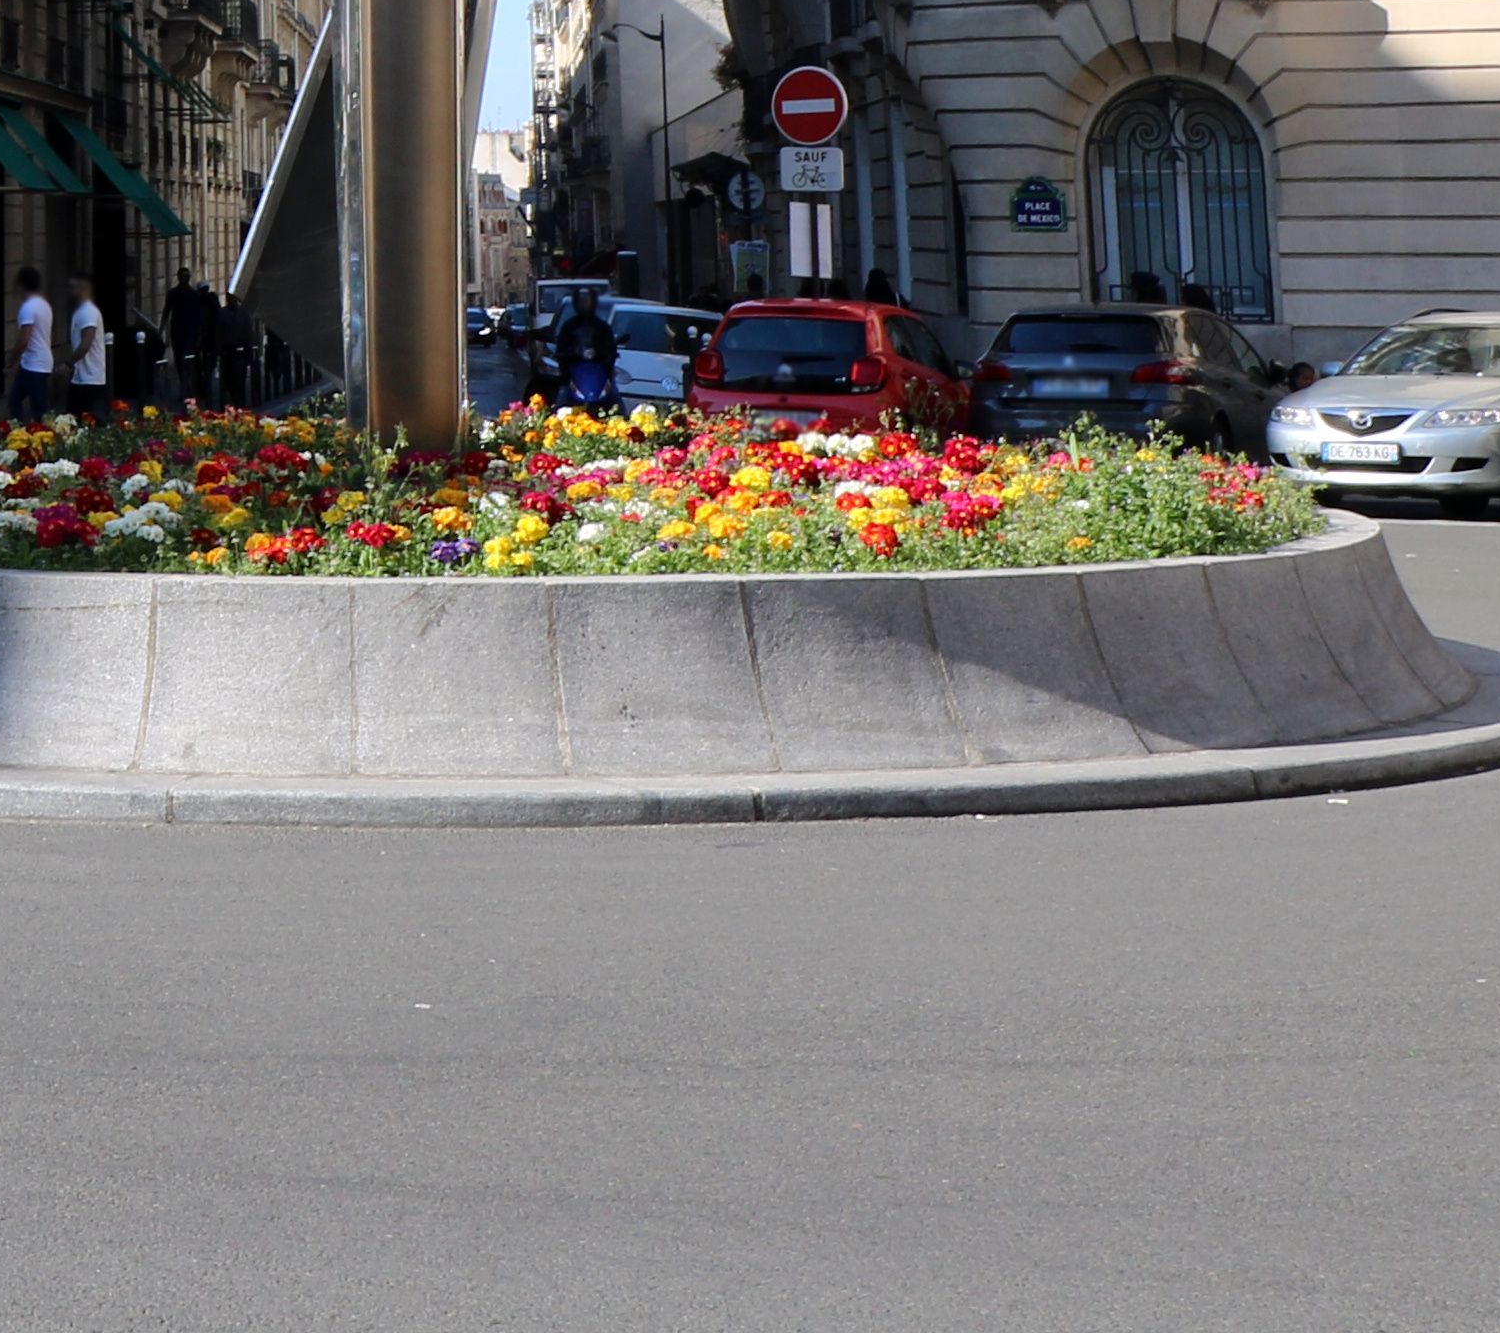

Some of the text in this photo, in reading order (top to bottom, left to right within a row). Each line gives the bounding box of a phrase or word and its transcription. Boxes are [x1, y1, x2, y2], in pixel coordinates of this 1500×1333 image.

[794, 151, 828, 163] SAUF
[1024, 201, 1051, 211] PLACE
[1017, 213, 1060, 223] DE MEXICO
